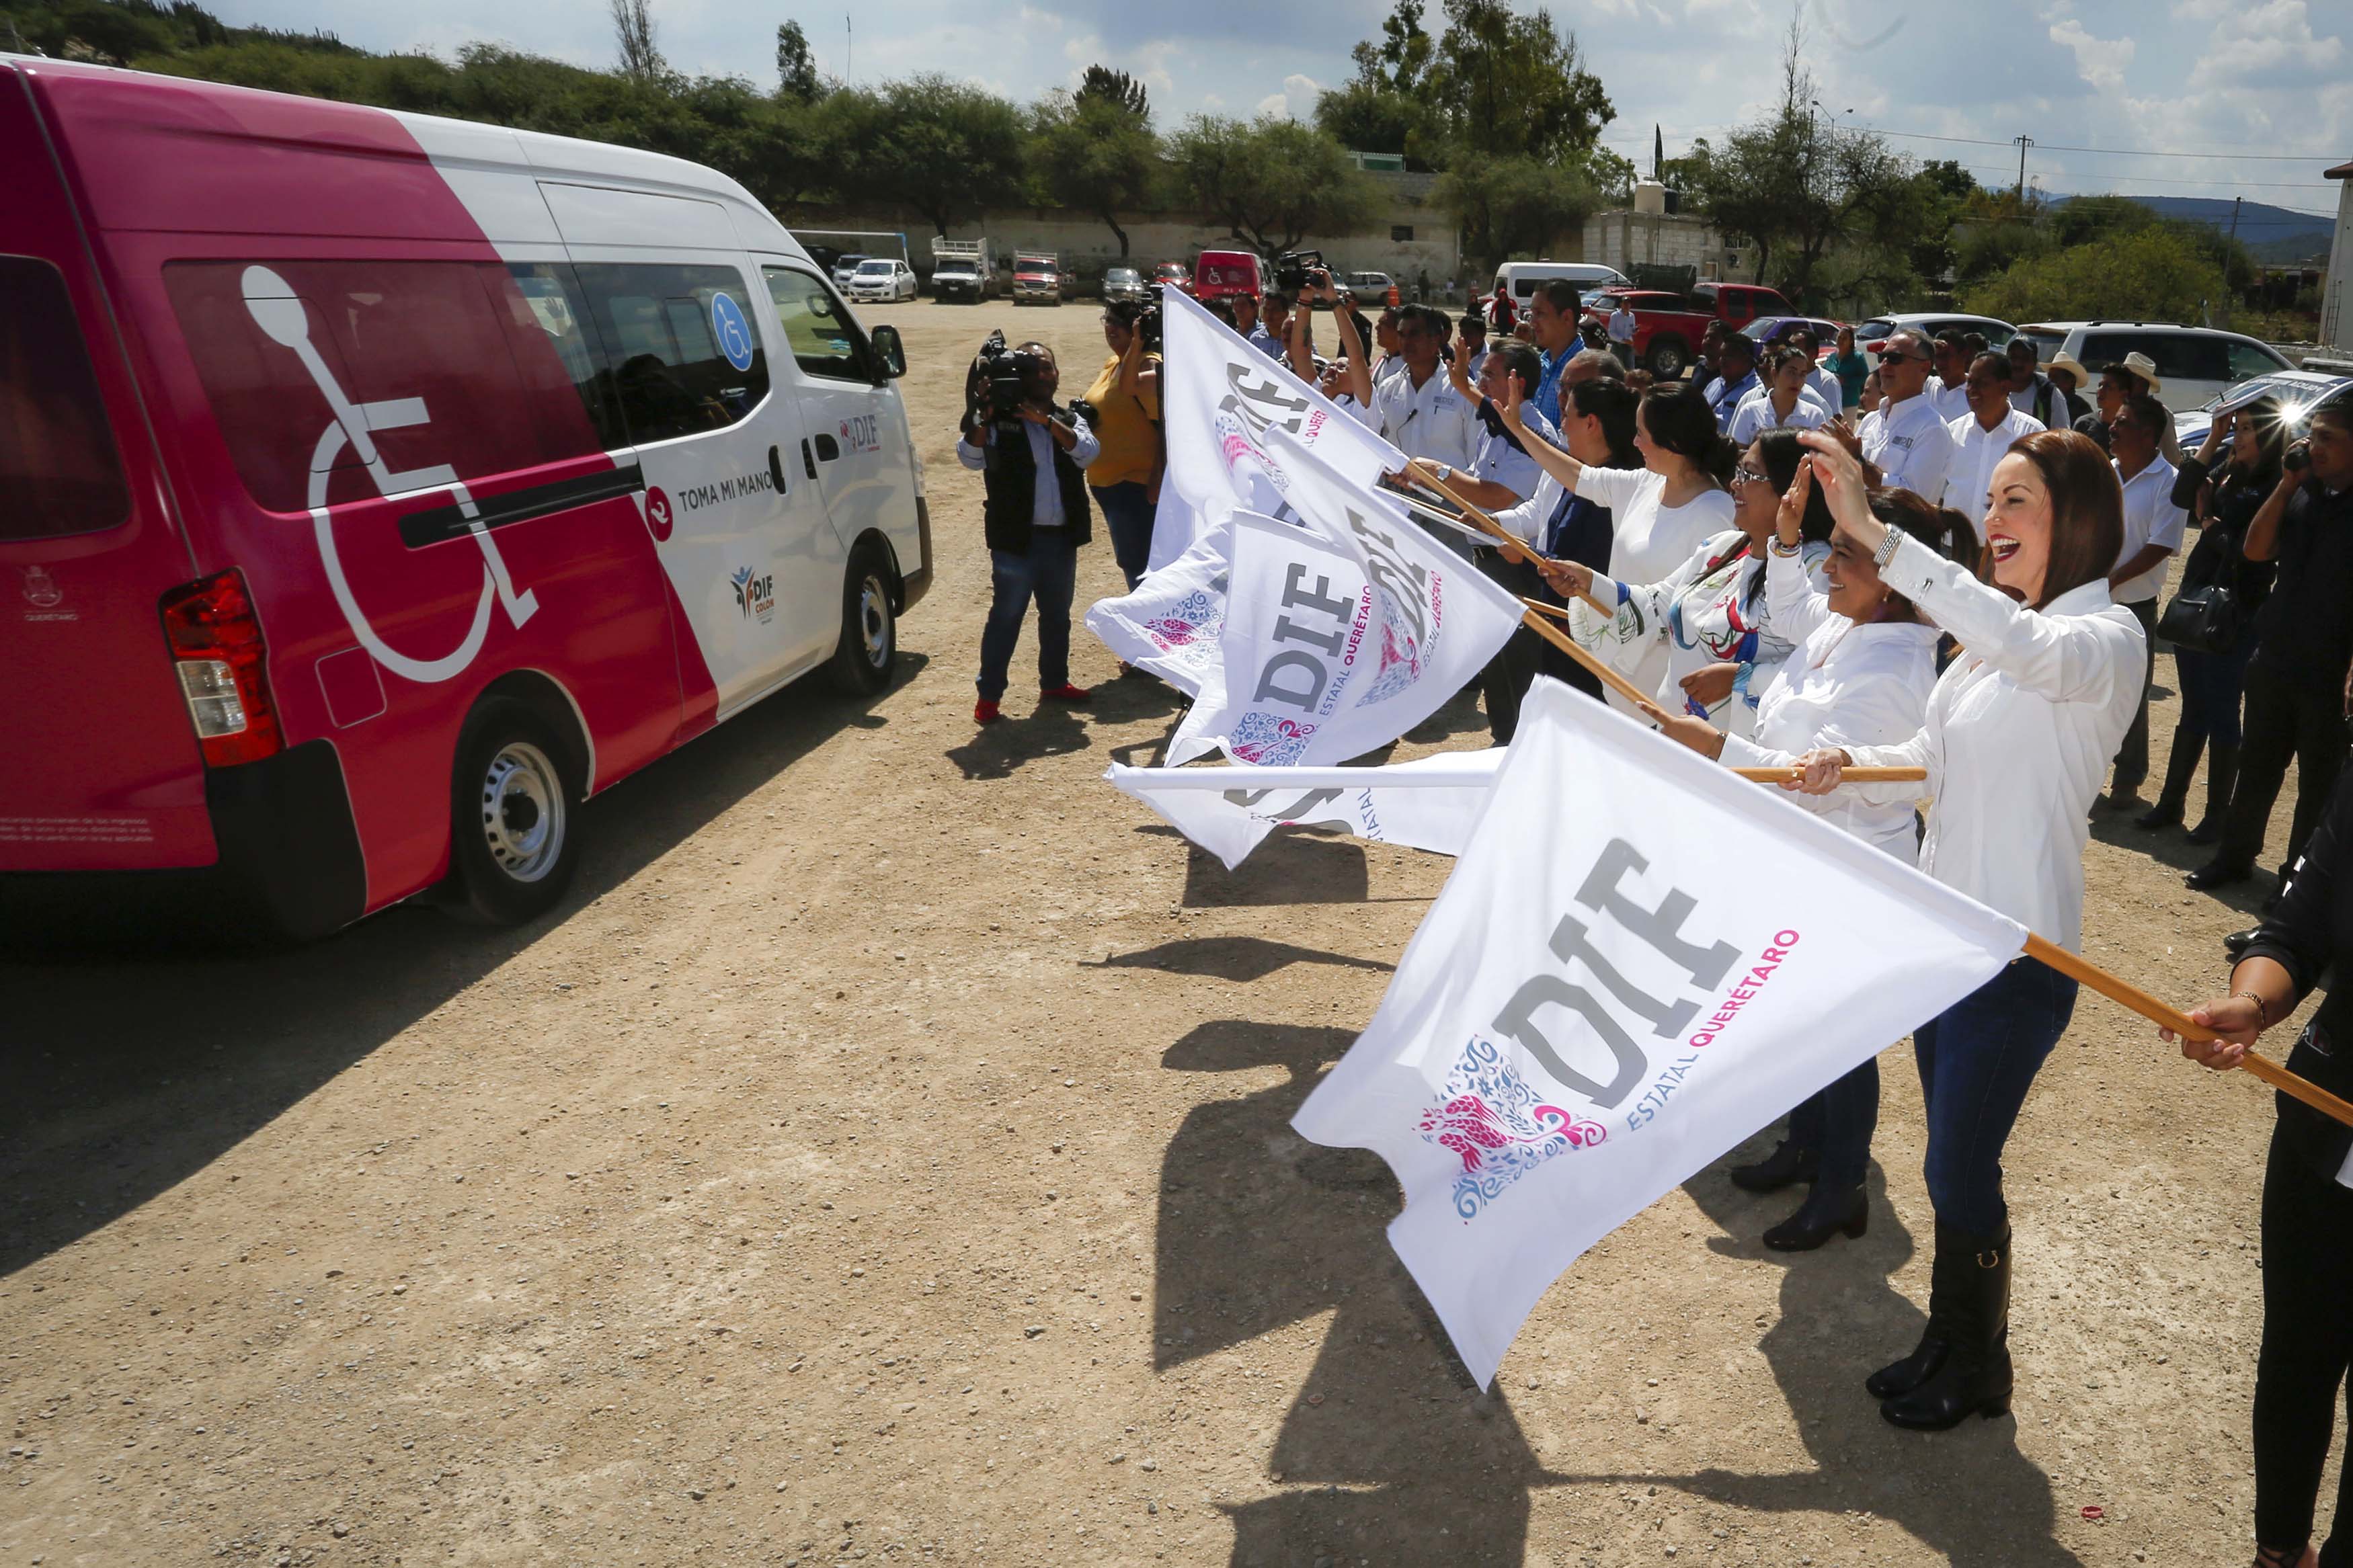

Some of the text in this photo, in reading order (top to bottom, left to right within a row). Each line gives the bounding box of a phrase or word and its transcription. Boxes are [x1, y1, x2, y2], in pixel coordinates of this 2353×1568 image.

[678, 470, 773, 512] TOMA MI MANO
[853, 414, 877, 446] DIF
[753, 575, 772, 602] DIF
[1252, 563, 1354, 713] DIF
[1319, 585, 1371, 716] ESTATAL QUERÉTARO
[1491, 837, 1743, 1110] DIF
[1626, 929, 1800, 1132] ESTATAL QUERÉTARO
